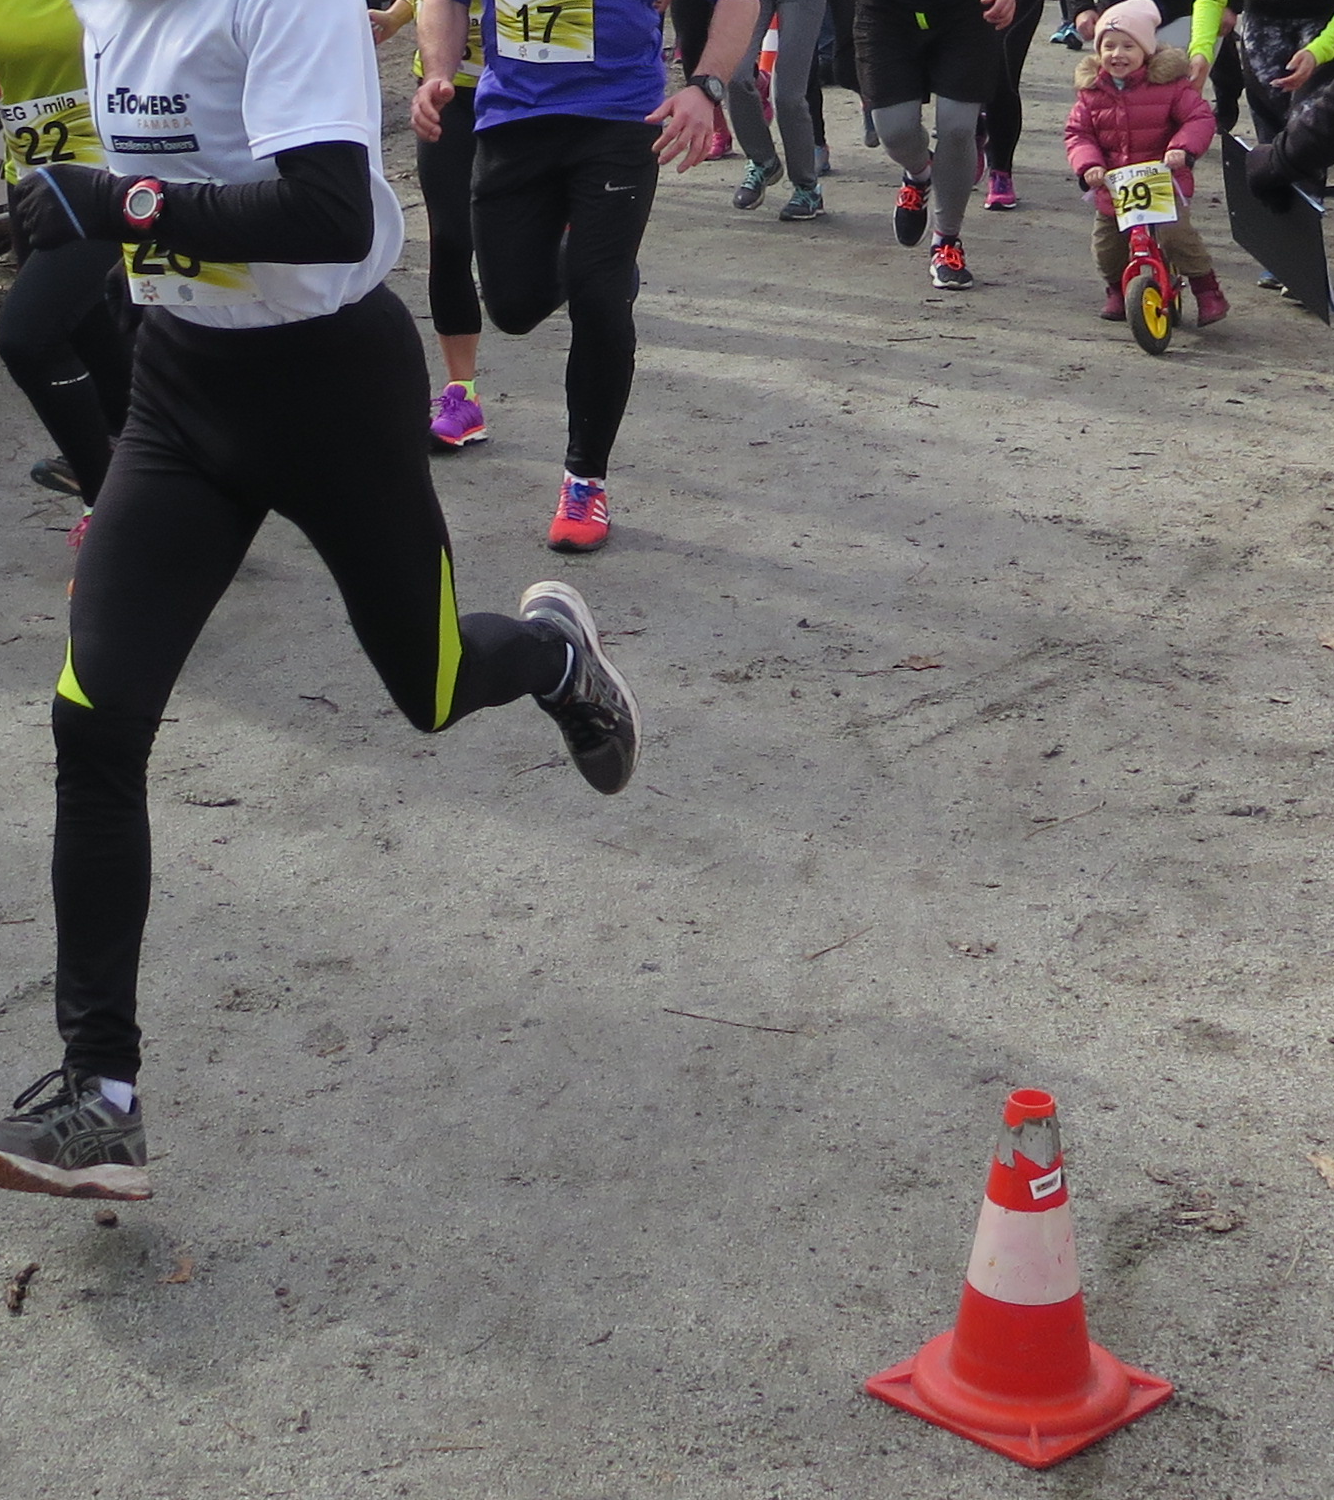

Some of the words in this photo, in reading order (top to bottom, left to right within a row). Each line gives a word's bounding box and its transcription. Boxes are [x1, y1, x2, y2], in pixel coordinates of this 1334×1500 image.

[516, 4, 562, 43] 17
[137, 117, 193, 130] FAMABA
[15, 120, 76, 165] 22
[1118, 182, 1152, 213] 29
